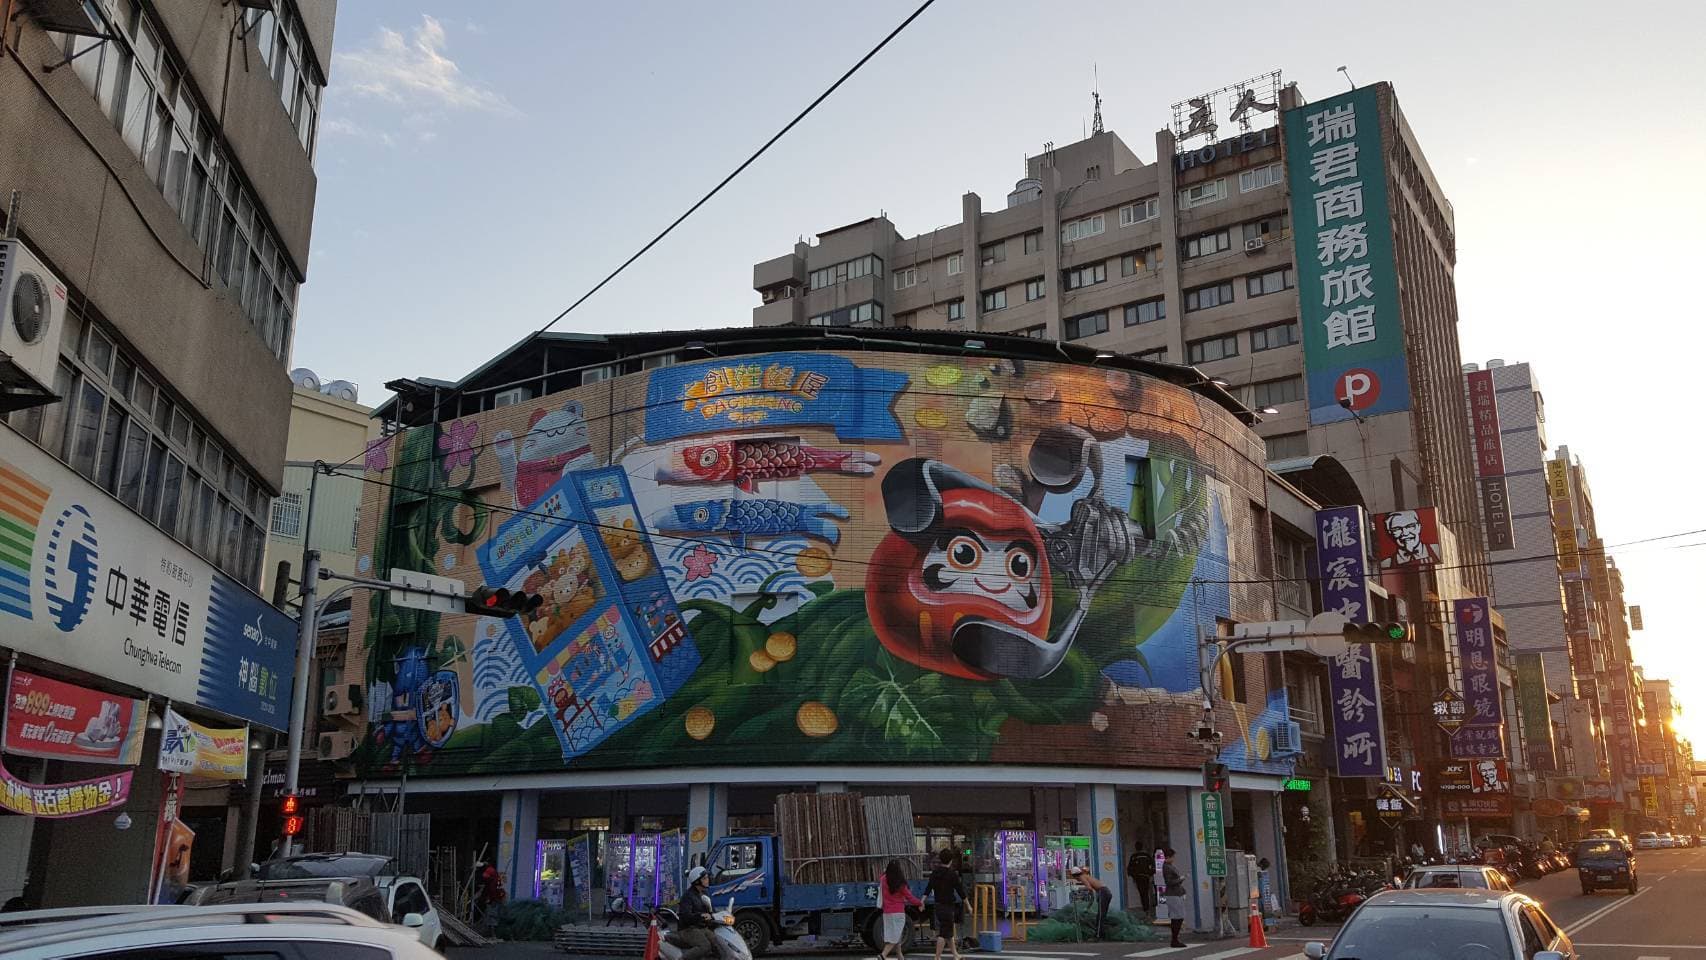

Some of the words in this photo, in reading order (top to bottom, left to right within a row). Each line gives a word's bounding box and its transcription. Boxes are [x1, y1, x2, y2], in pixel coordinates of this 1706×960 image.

[1178, 130, 1277, 171] HOTEL
[1305, 102, 1377, 350] 瑞君商務旅館
[1475, 380, 1498, 466] 君瑞精品旅店
[1488, 482, 1505, 528] HOTEL
[105, 566, 191, 647] 中華電信
[124, 637, 158, 667] Chunghwa
[158, 650, 182, 674] Telecom
[1465, 627, 1496, 718] 明恩眼鏡
